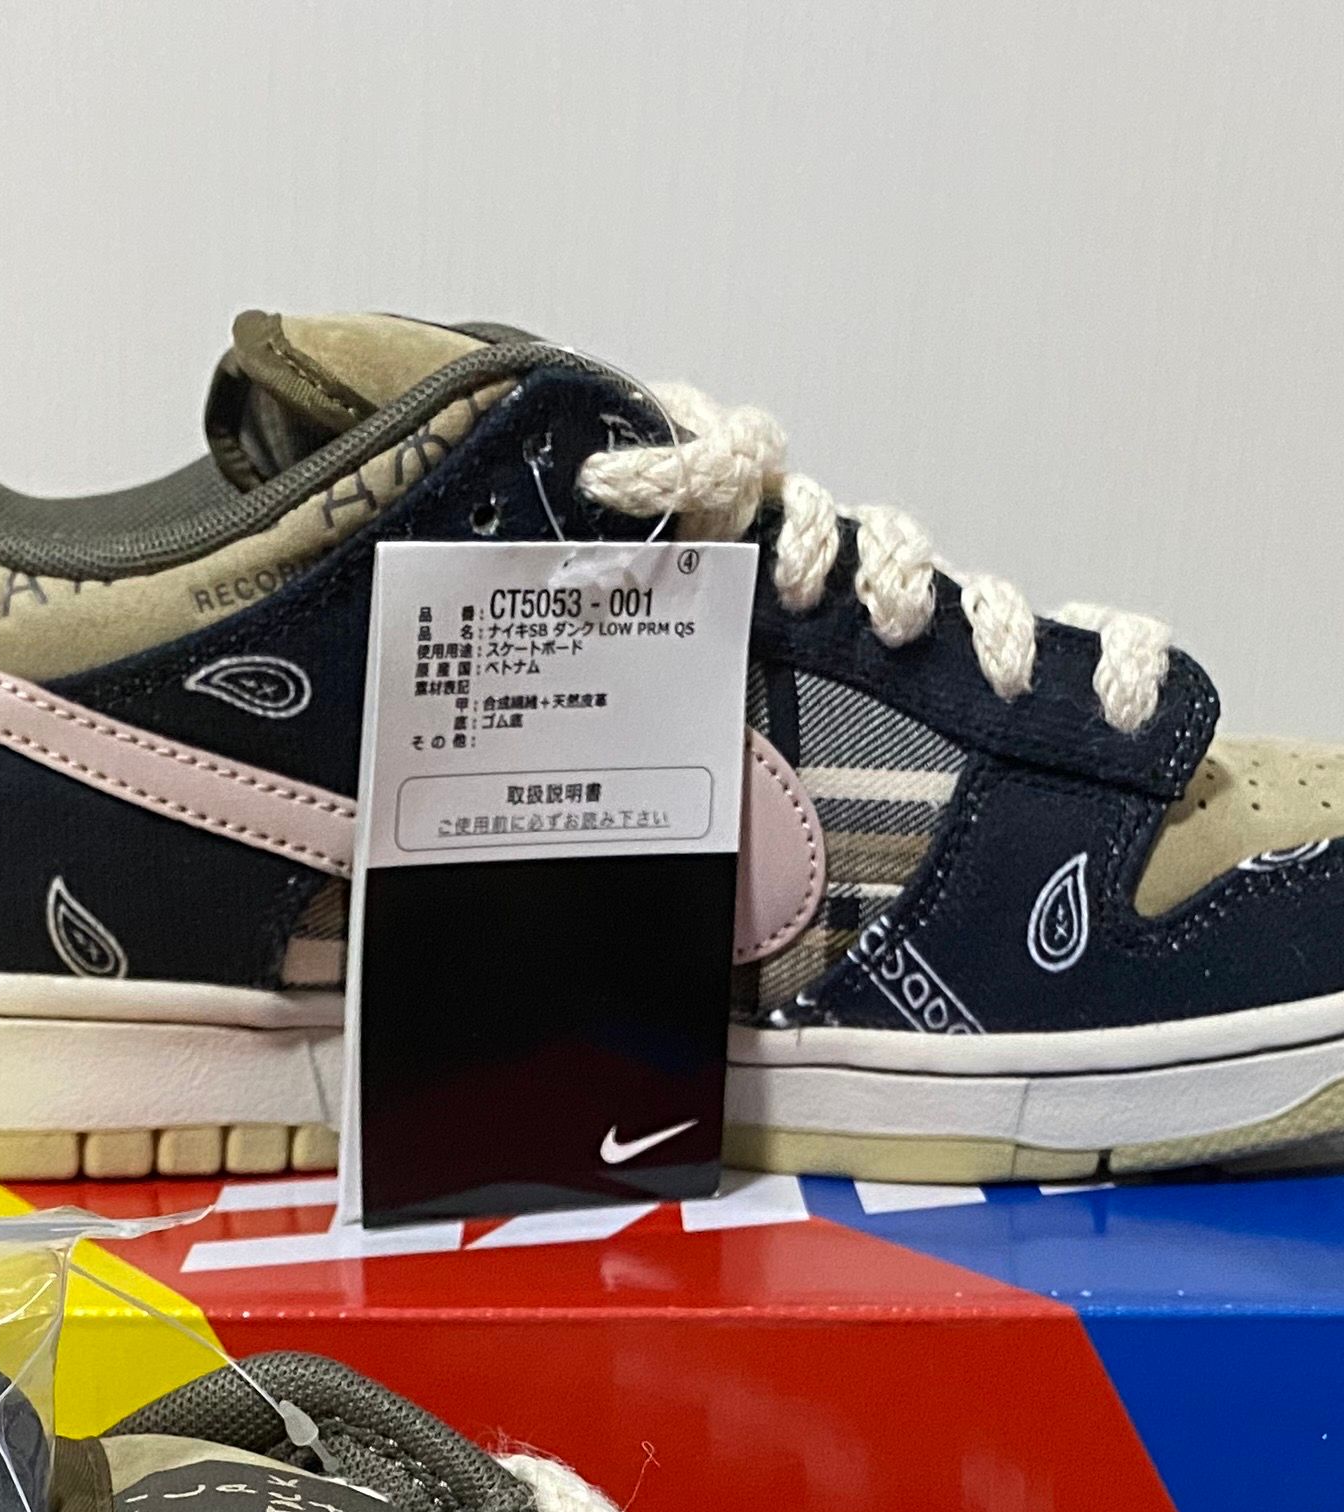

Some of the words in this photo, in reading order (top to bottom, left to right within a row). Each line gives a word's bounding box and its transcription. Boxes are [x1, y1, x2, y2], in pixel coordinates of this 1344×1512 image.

[490, 588, 582, 619] CT5053
[609, 587, 653, 617] 001
[599, 622, 632, 636] LOW
[637, 622, 669, 635] PRM
[674, 622, 695, 638] QS
